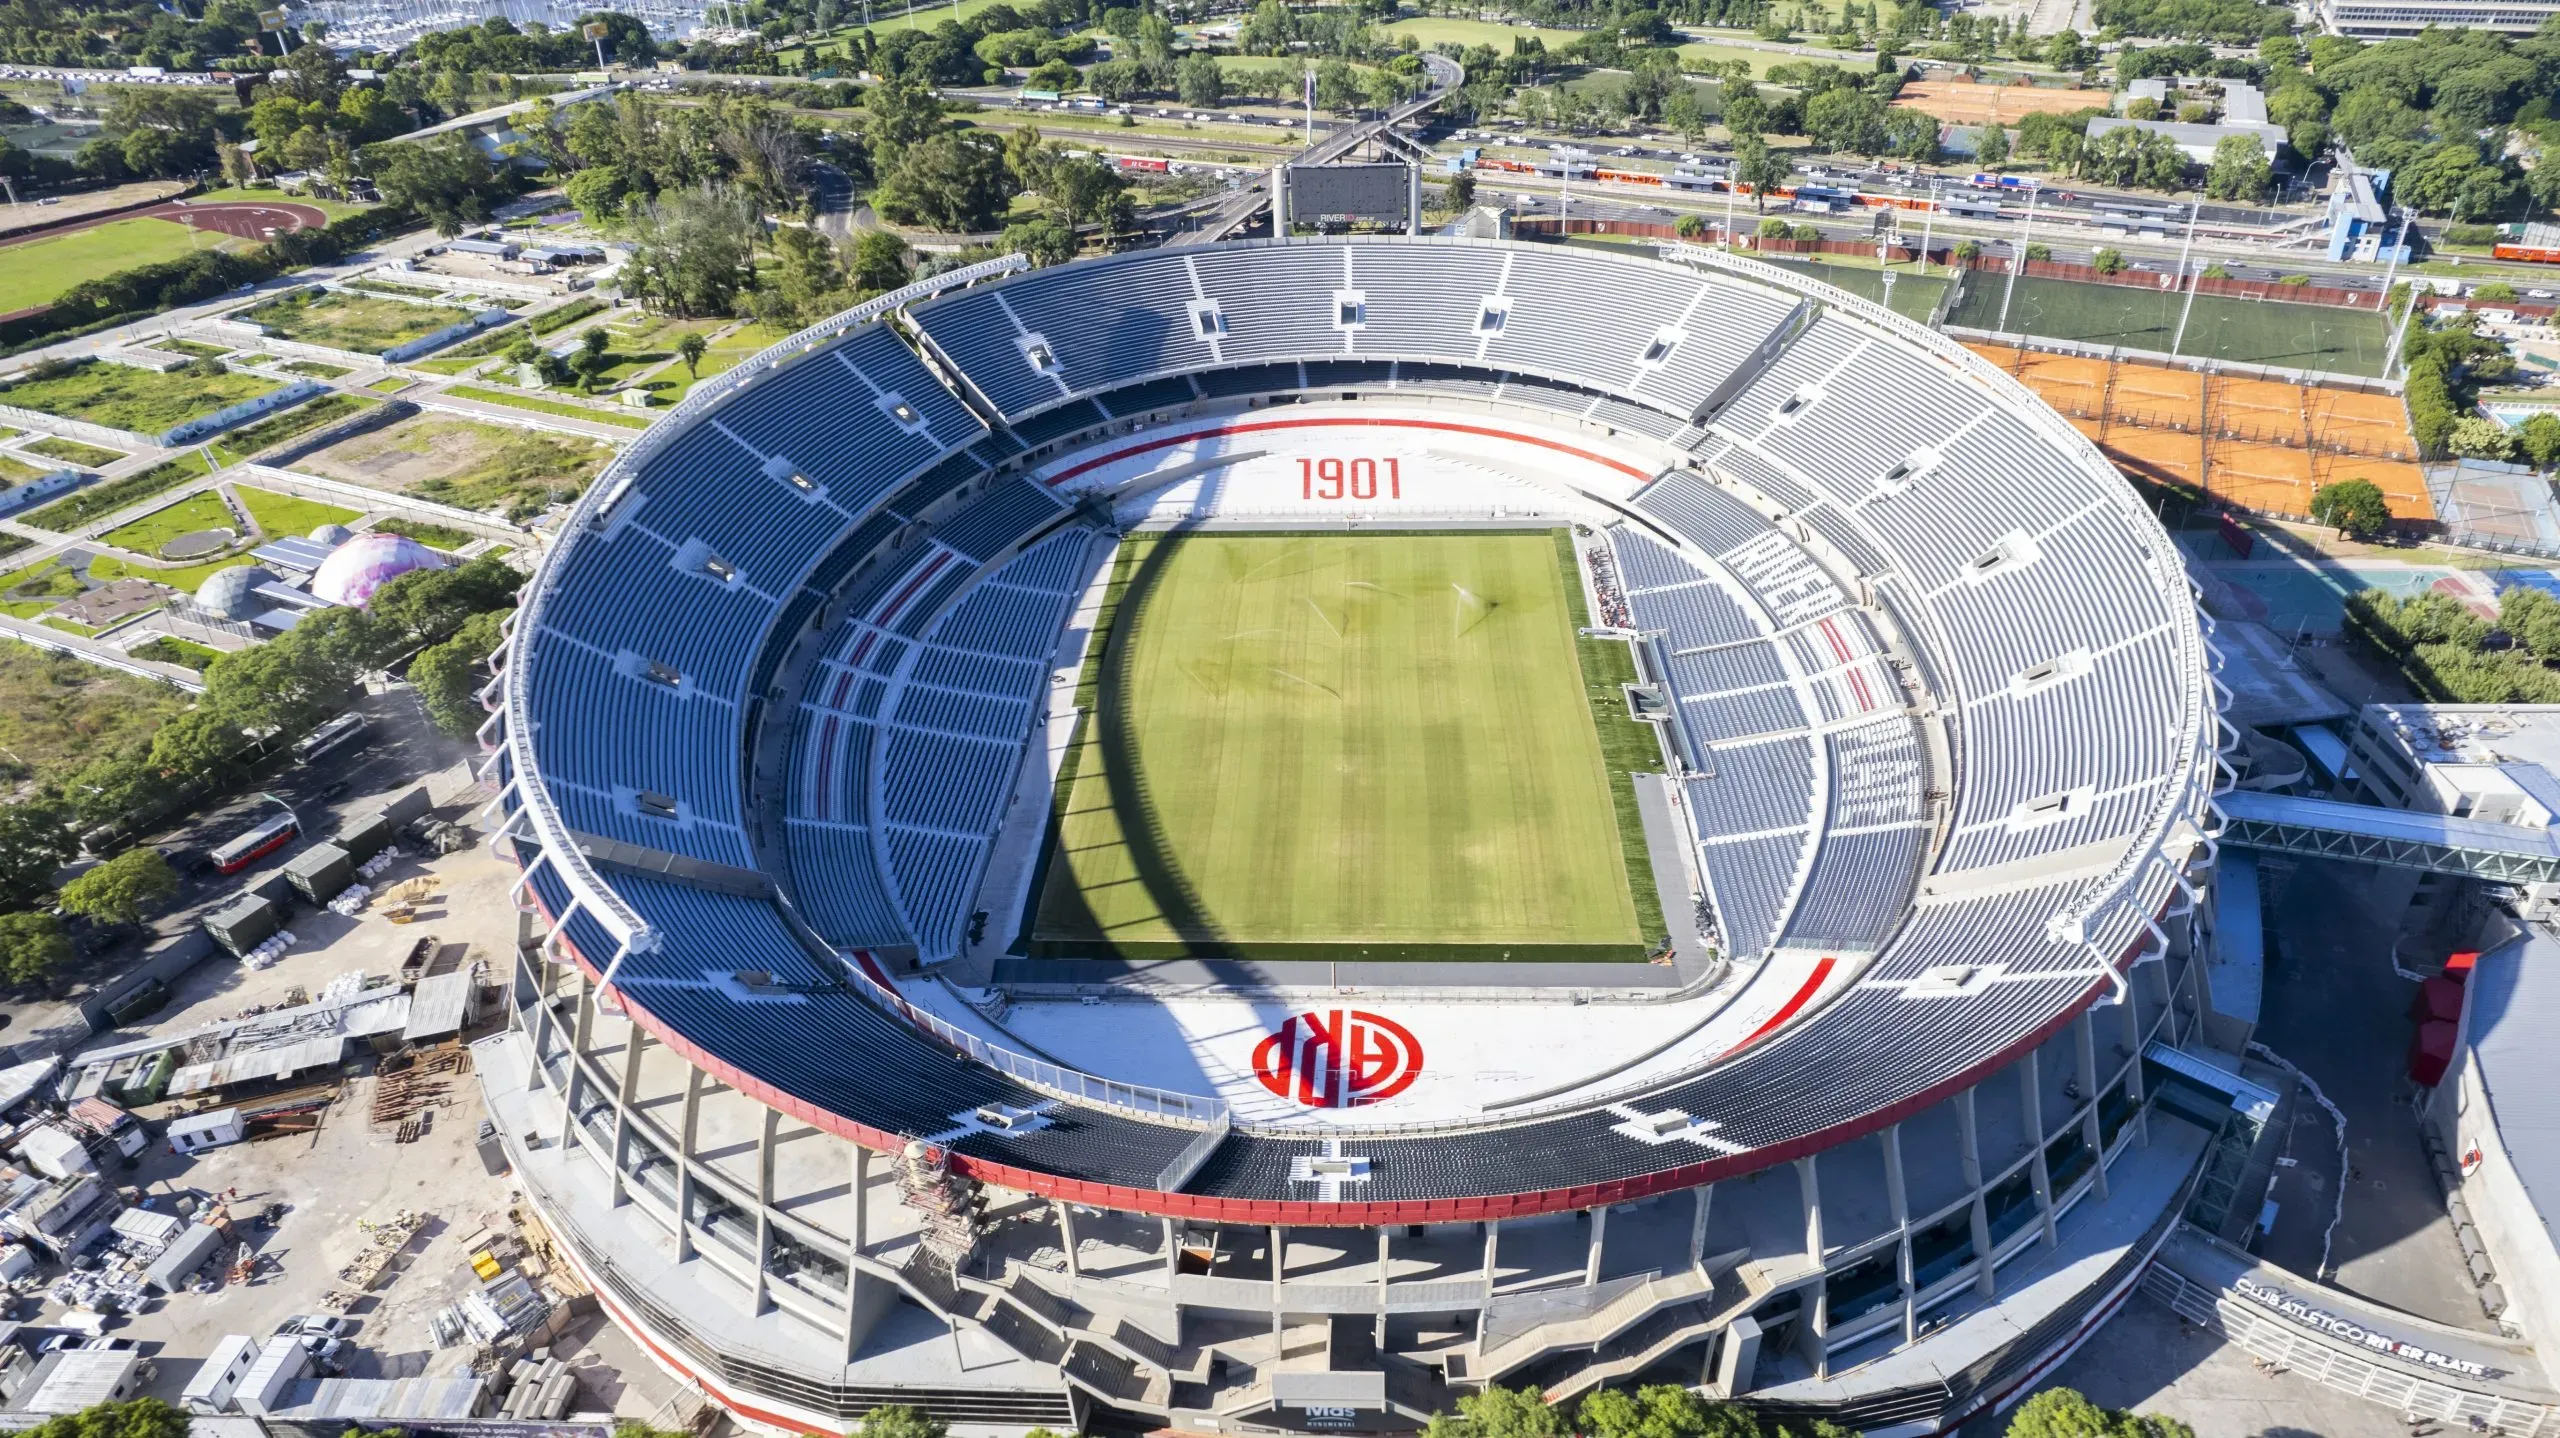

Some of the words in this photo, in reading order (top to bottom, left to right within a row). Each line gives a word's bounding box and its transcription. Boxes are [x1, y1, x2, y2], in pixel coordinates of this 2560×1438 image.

[1296, 458, 1400, 499] 1901
[2235, 1278, 2280, 1305] CLUB
[2280, 1302, 2364, 1340] ATLETICO
[2365, 1334, 2424, 1361] RIVER
[2424, 1352, 2484, 1375] PLATE
